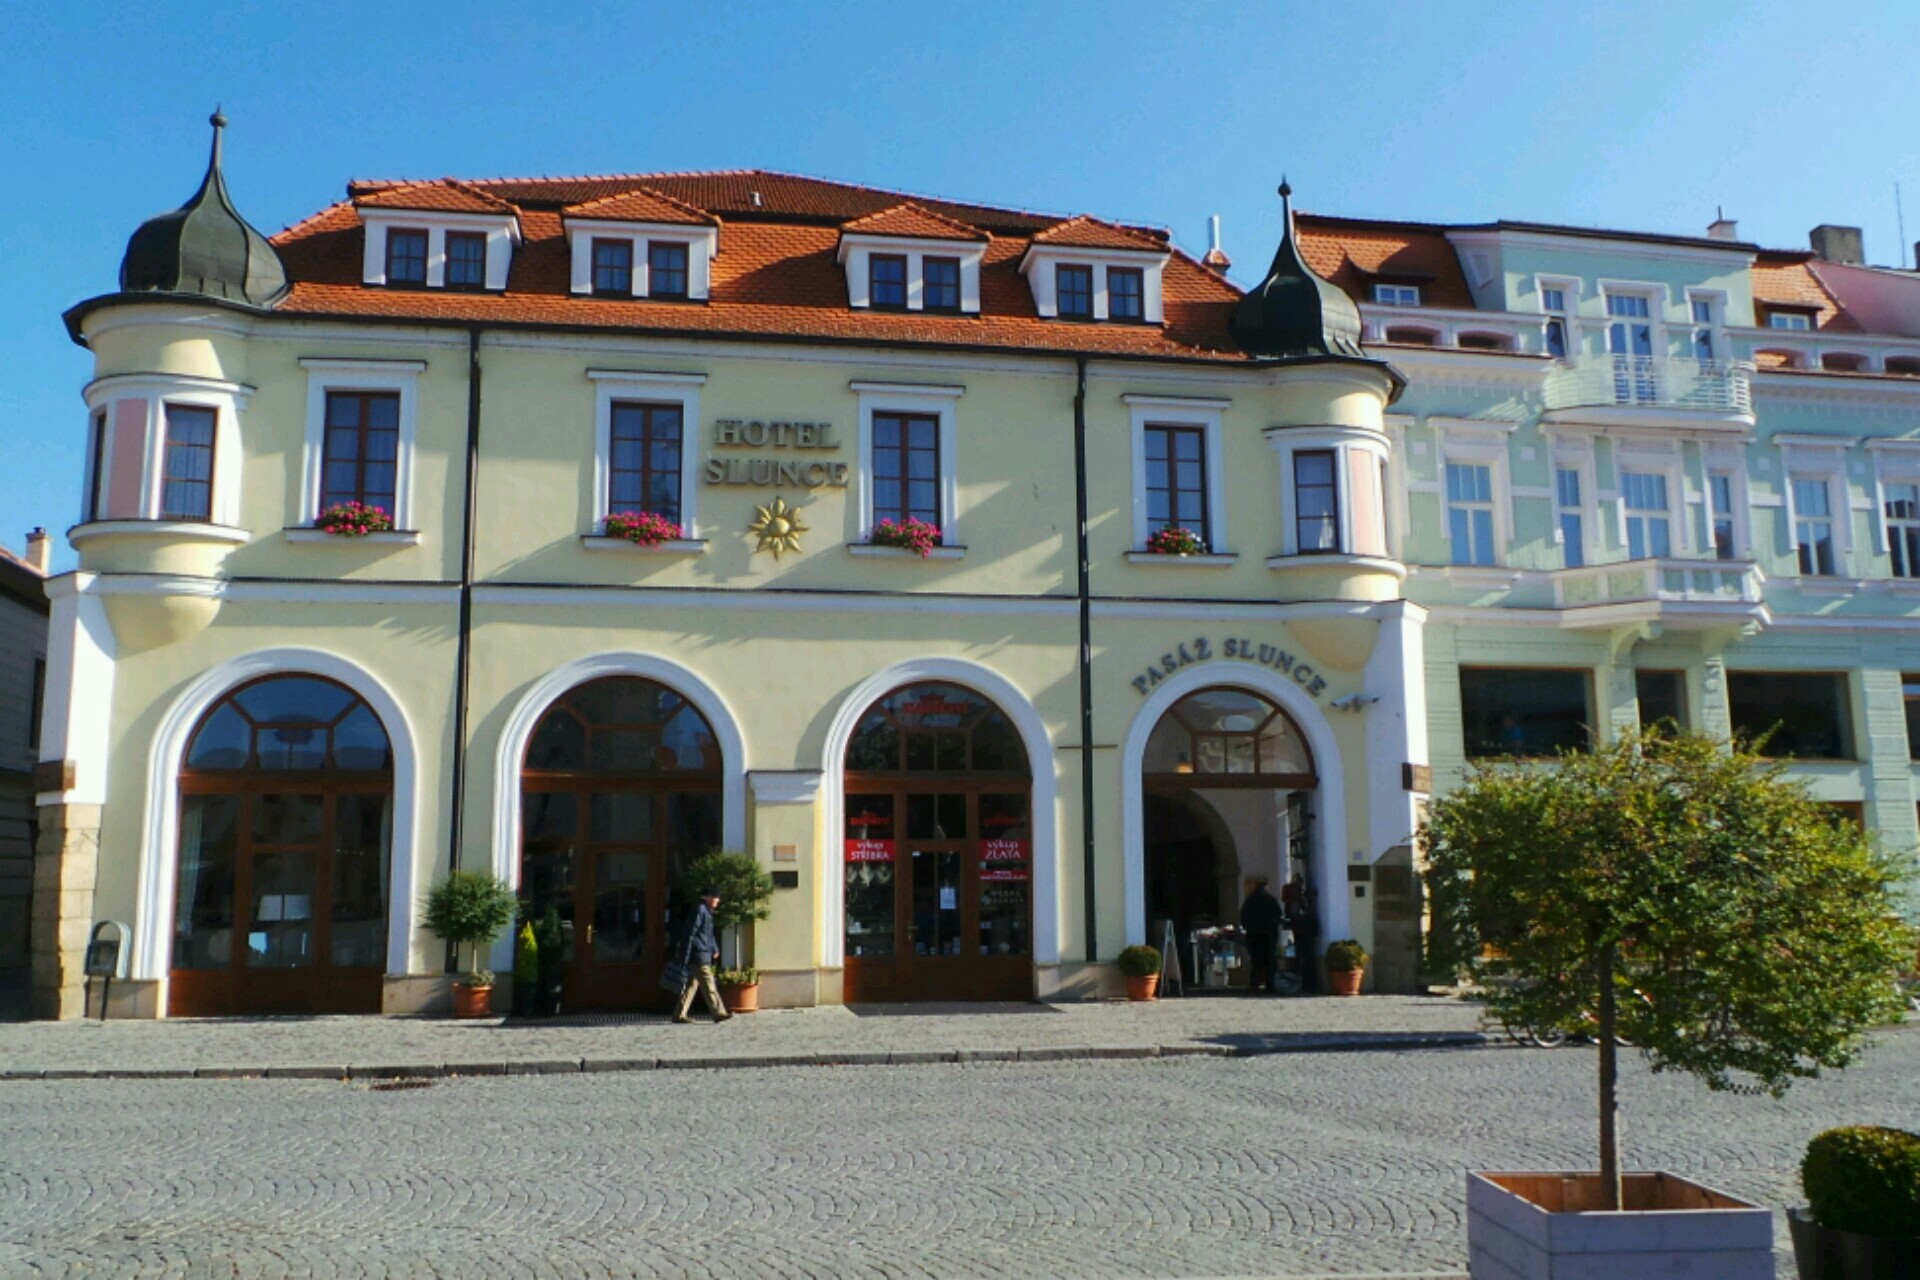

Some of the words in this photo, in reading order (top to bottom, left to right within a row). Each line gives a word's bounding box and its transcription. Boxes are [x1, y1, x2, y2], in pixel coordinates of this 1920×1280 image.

[715, 420, 840, 448] HOTEL
[705, 459, 849, 488] SLUNCE
[1223, 638, 1327, 697] SLUNCE
[985, 849, 1021, 860] ZLATA
